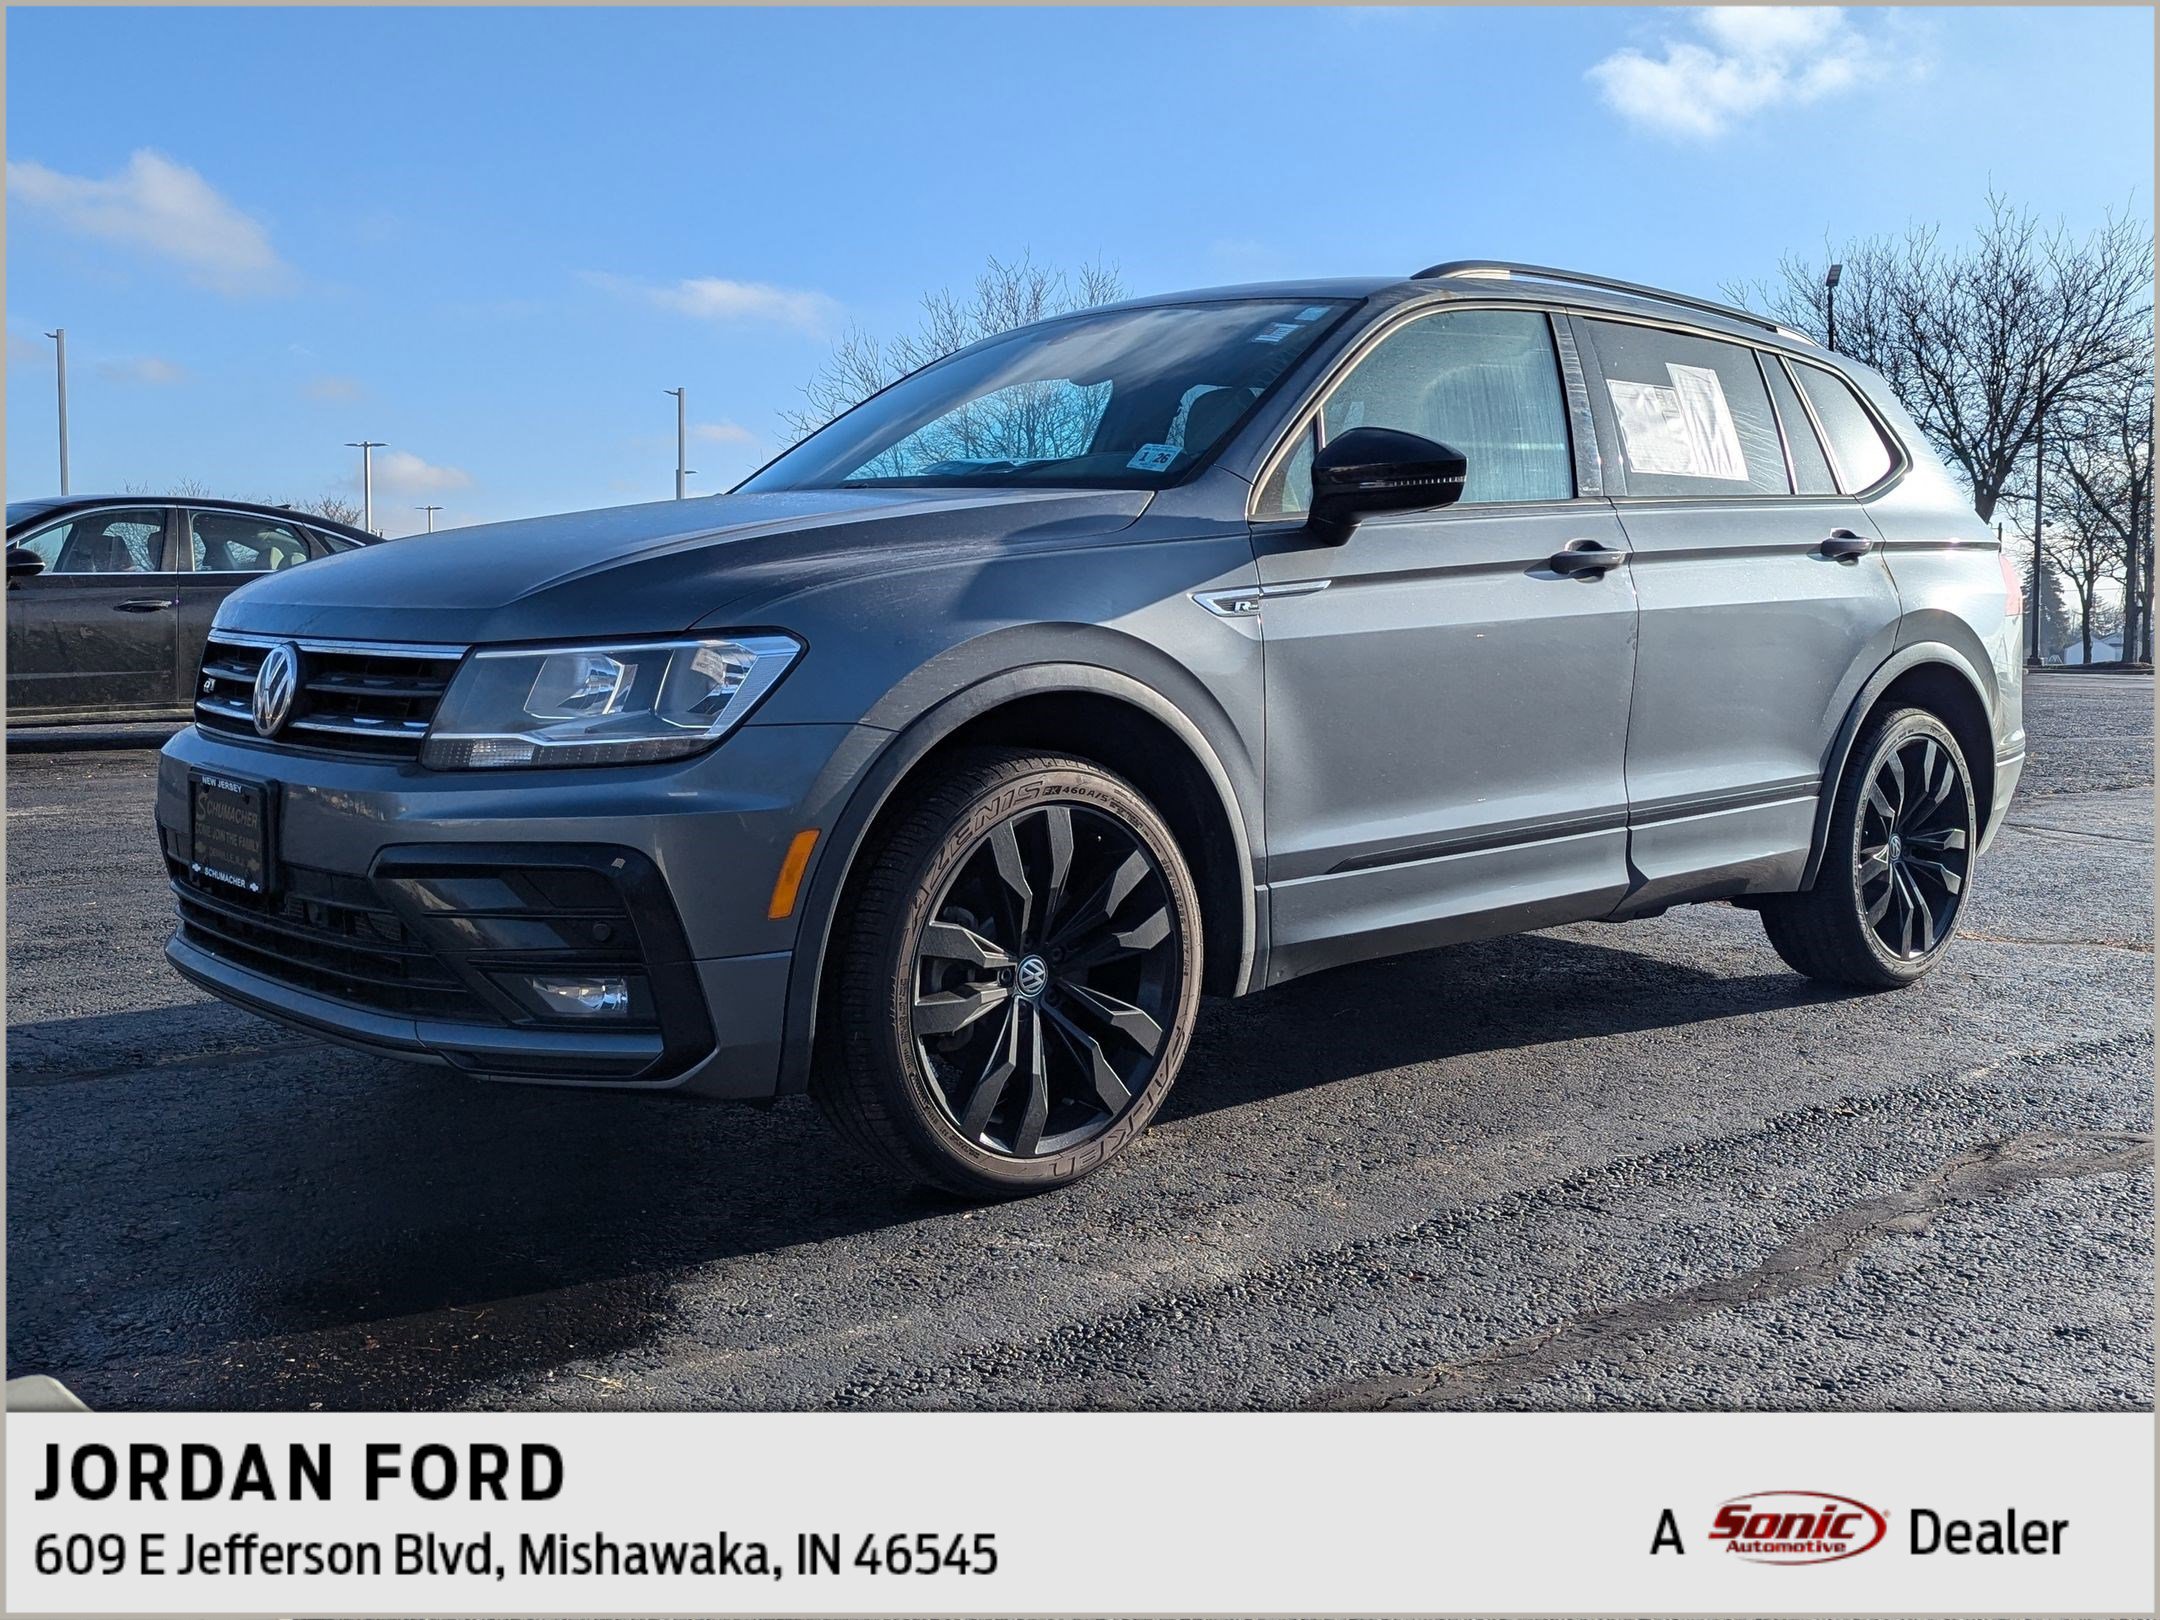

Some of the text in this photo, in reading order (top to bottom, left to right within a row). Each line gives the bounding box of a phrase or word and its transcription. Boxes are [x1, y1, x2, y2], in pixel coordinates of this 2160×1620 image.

[1138, 451, 1171, 464] 1 26
[202, 775, 242, 793] NEW JERSEY
[1062, 786, 1086, 795] 460
[204, 866, 246, 889] SCHUMACHER
